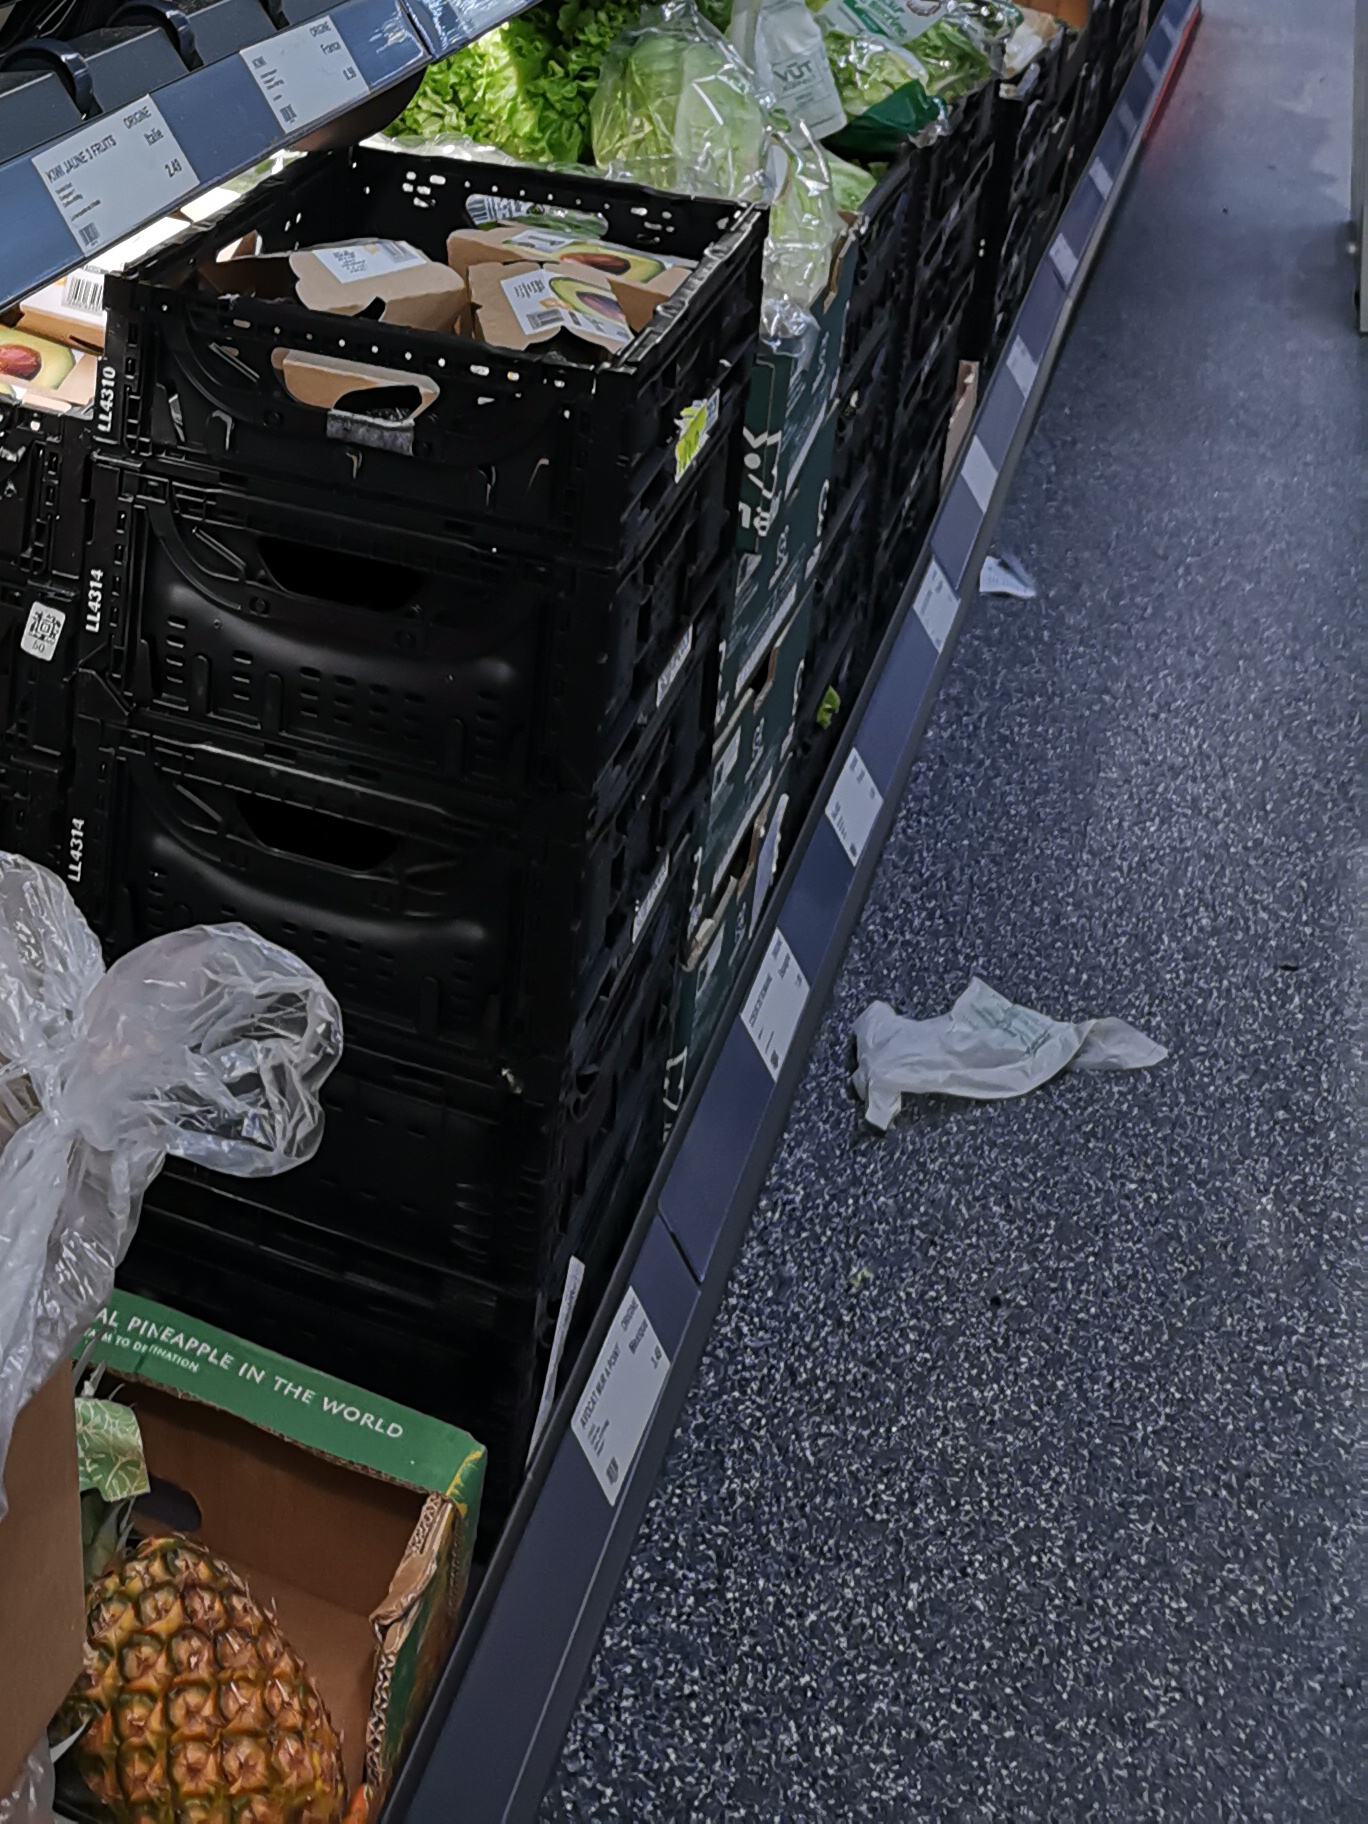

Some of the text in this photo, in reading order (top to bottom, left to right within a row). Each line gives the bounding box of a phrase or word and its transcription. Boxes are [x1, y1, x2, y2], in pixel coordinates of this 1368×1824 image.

[123, 106, 152, 129] ORIGINE
[64, 150, 88, 174] JAUNE
[91, 134, 117, 160] FRUITS
[97, 366, 116, 433] LL4310
[85, 568, 104, 633] LL4314
[67, 817, 85, 882] LL4314
[95, 1307, 119, 1328] AL
[127, 1316, 235, 1370] PINEAPPLE
[238, 1361, 266, 1385] IN
[274, 1375, 317, 1405] THE
[322, 1396, 404, 1439] WORLD
[115, 1336, 131, 1350] TO
